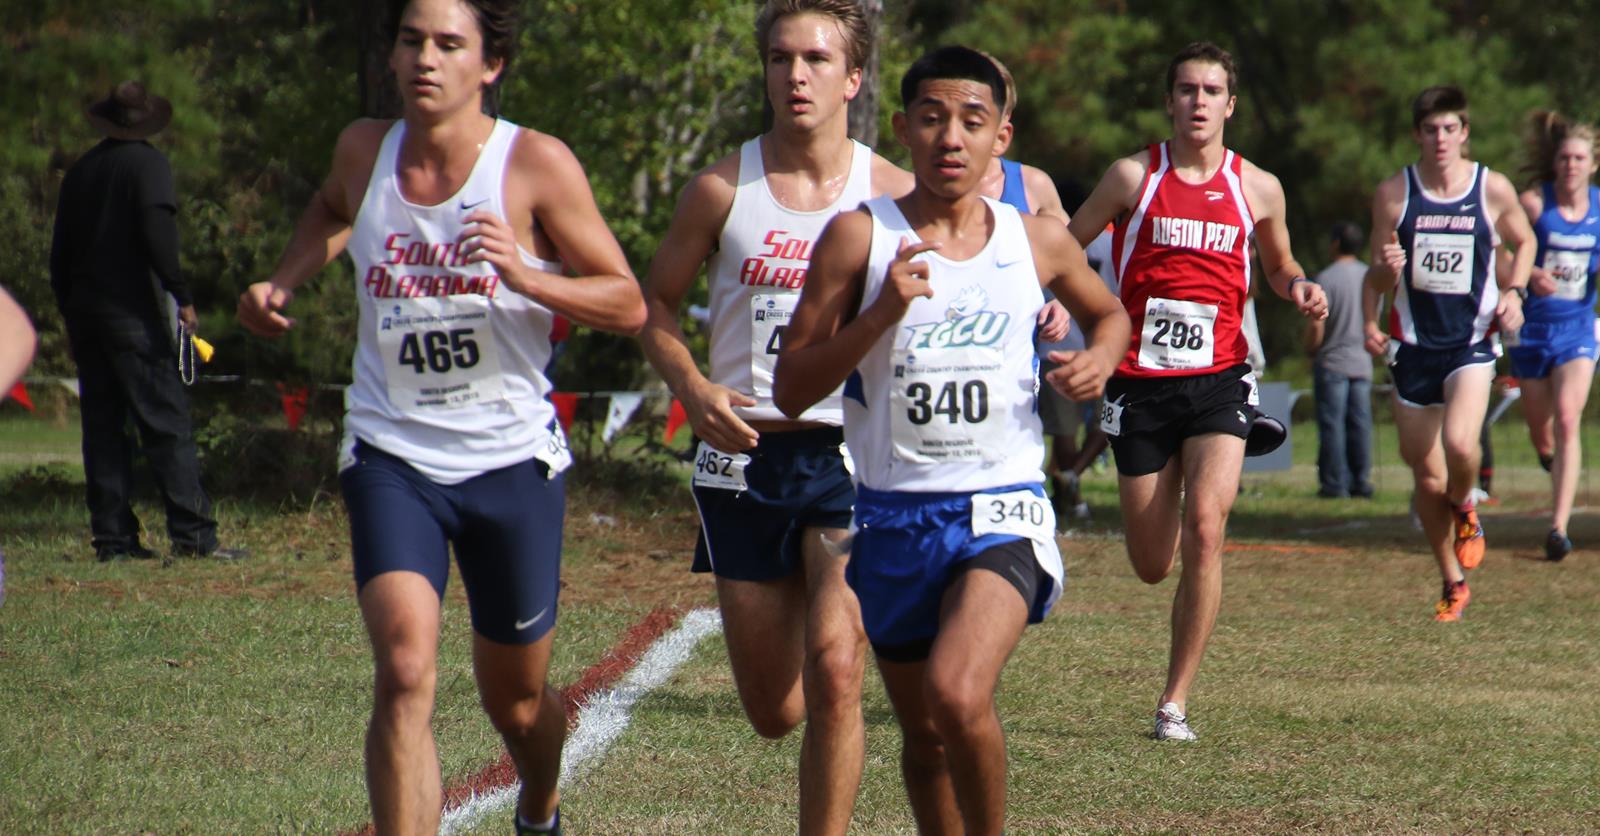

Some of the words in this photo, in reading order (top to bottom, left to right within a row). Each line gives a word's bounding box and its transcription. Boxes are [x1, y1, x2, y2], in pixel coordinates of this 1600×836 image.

[1152, 216, 1204, 249] AUSTIN
[1204, 222, 1240, 253] PEAY
[1415, 214, 1476, 231] SAMFORD
[1422, 251, 1463, 273] 452
[364, 265, 500, 298] ALABAMA
[904, 310, 1010, 348] FGCU
[1152, 318, 1204, 351] 298
[398, 328, 480, 374] 465
[906, 379, 989, 425] 340
[697, 450, 734, 477] 462
[990, 500, 1044, 526] 340
